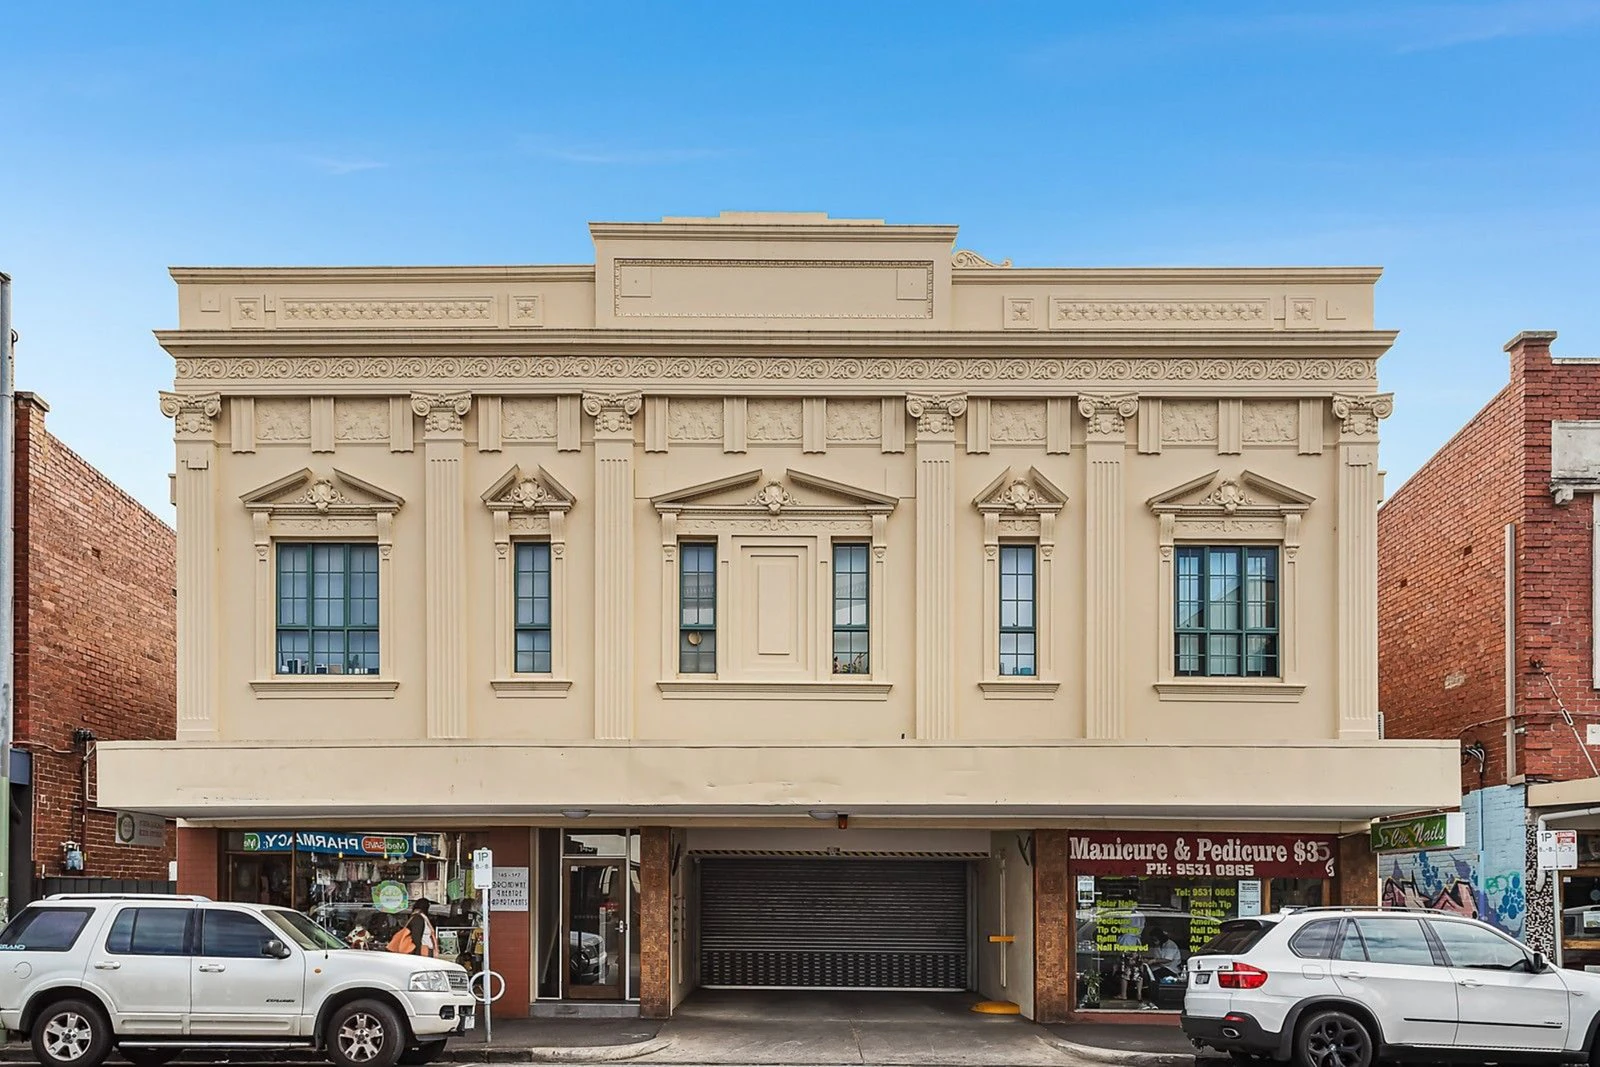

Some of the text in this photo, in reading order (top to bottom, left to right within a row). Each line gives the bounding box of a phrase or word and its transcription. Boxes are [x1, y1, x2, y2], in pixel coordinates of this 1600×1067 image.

[1413, 822, 1445, 843] Nails
[1541, 832, 1552, 842] 1P
[1069, 837, 1331, 865] Manicure & Pedicure $35
[478, 852, 489, 862] 1P
[1146, 863, 1255, 877] PH: 9531 0865
[1174, 888, 1236, 897] Tel: 9531 0865
[1096, 900, 1117, 908] Solar
[1190, 900, 1231, 910] French Tip
[1205, 909, 1225, 917] Nails
[1096, 926, 1109, 935] Tip
[1096, 935, 1117, 943] Refill
[1190, 935, 1202, 943] Air
